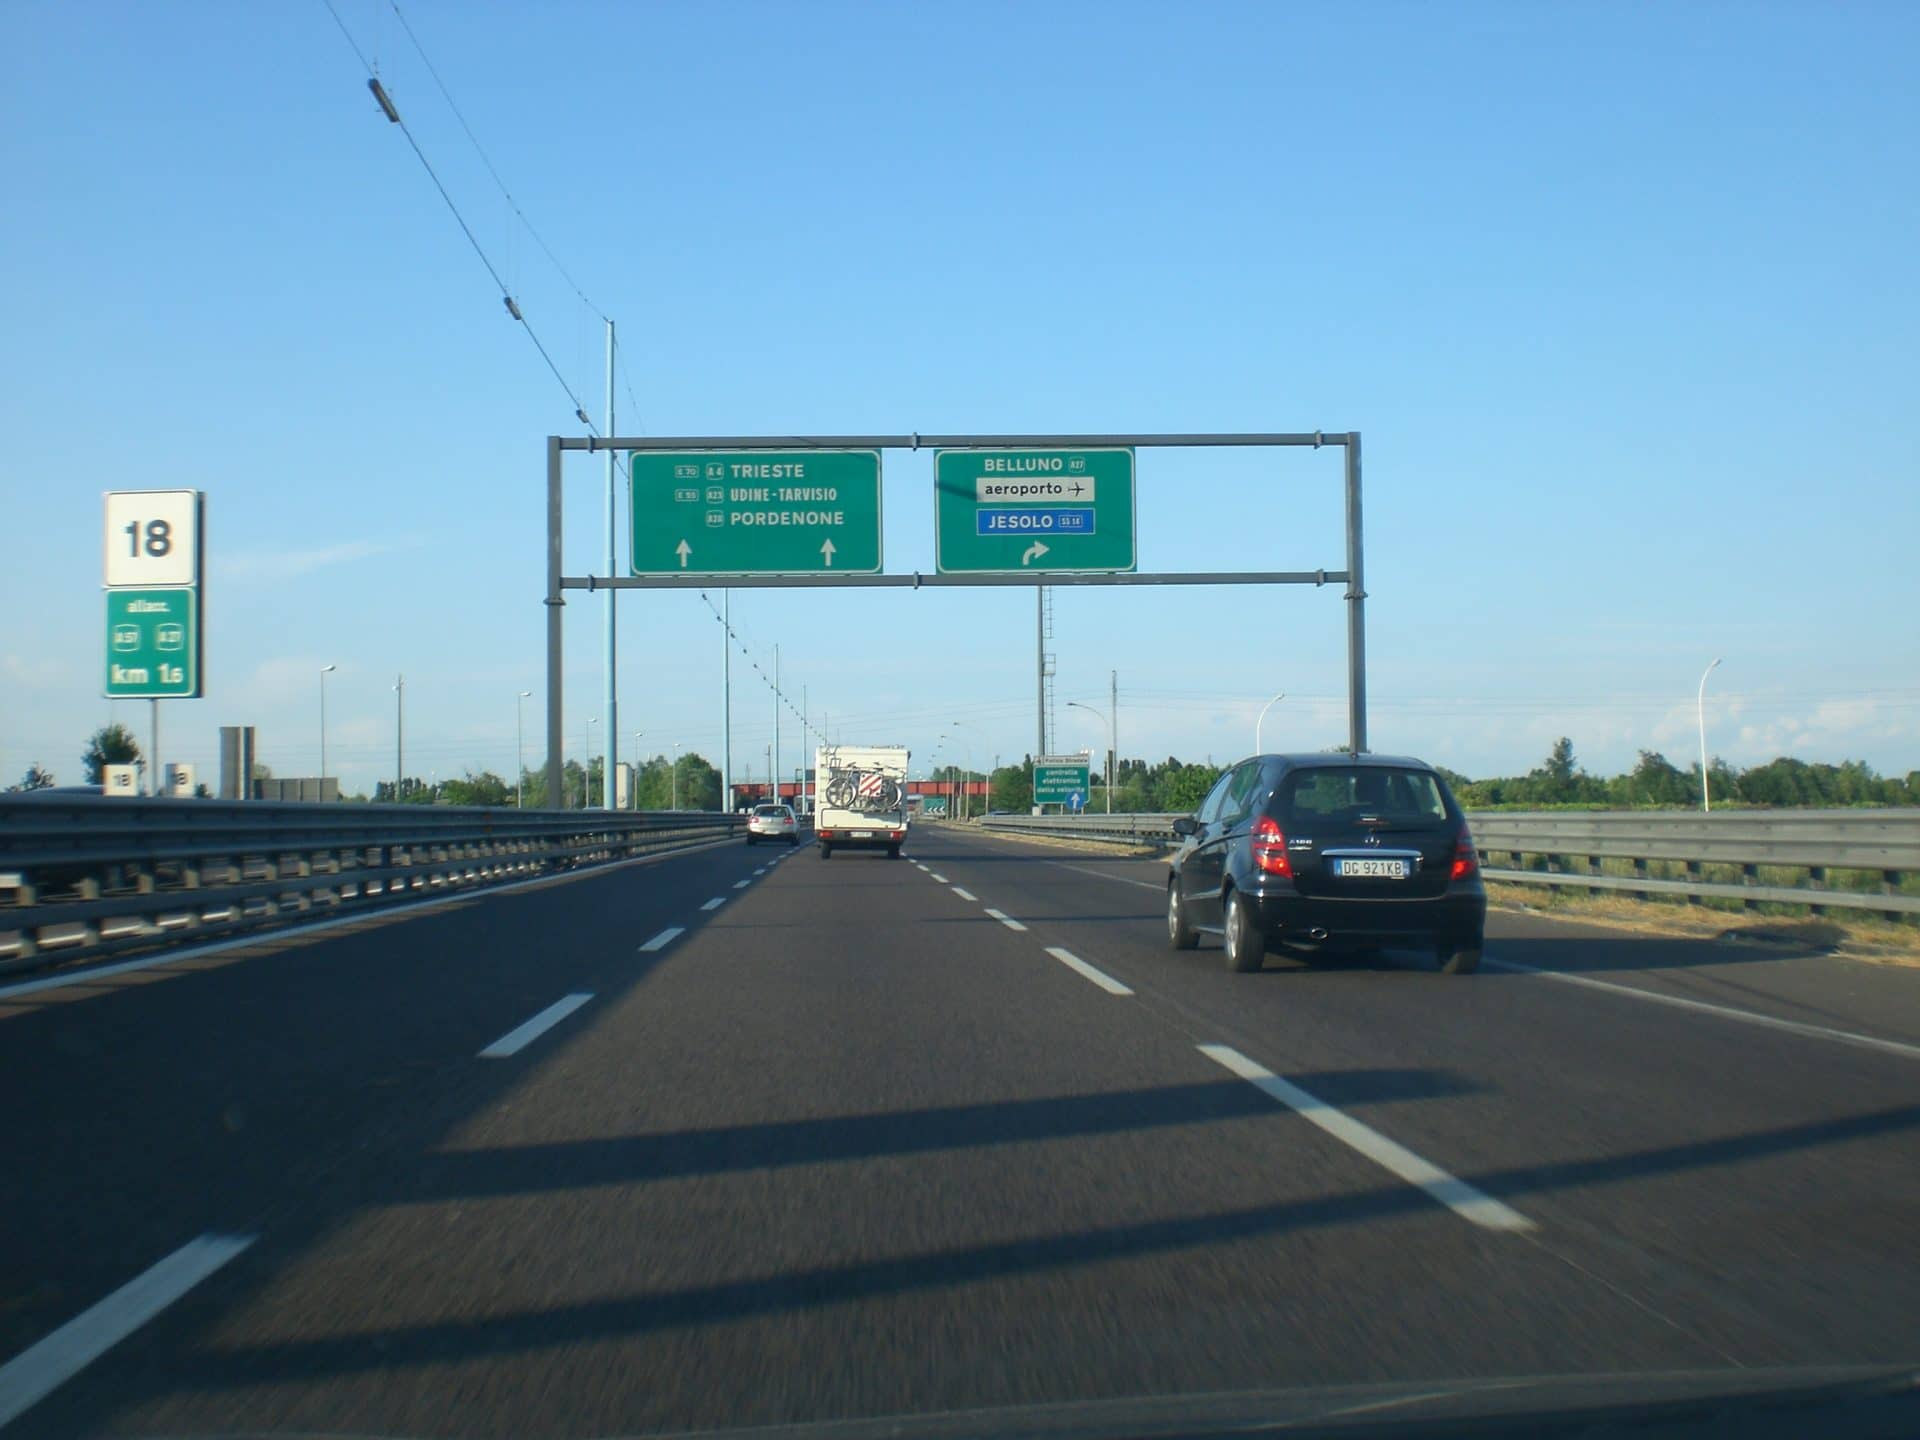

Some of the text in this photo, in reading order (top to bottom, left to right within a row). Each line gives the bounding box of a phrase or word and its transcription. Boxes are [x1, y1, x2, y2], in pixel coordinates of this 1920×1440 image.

[731, 464, 805, 479] TRIESTE
[984, 457, 1063, 472] BELLUNO
[985, 482, 1063, 497] aeroporto
[730, 511, 844, 526] PORDENONE
[988, 515, 1053, 529] JESOLO
[124, 519, 173, 558] 18
[111, 663, 149, 684] km
